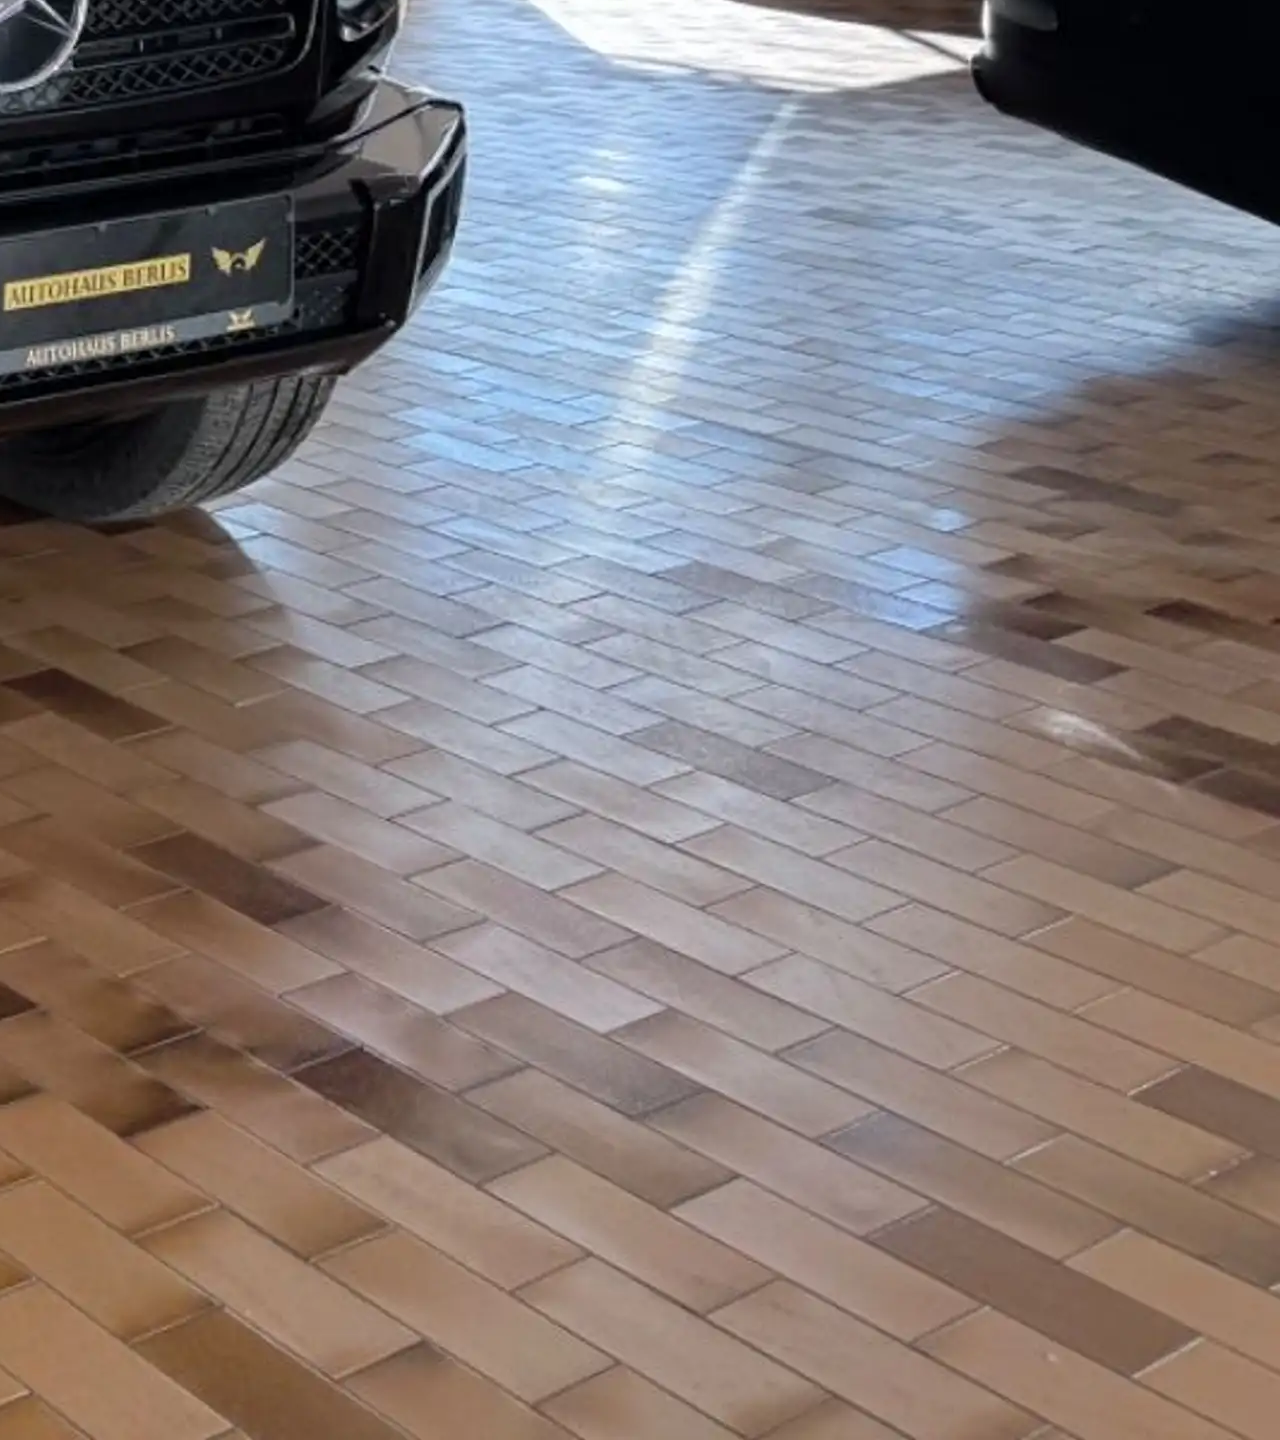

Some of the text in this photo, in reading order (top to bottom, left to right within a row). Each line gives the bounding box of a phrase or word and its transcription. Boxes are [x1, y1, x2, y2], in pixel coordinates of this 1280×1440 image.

[10, 259, 186, 307] AUTOHAUS BERLIS
[26, 335, 115, 367] AUTOHAUS
